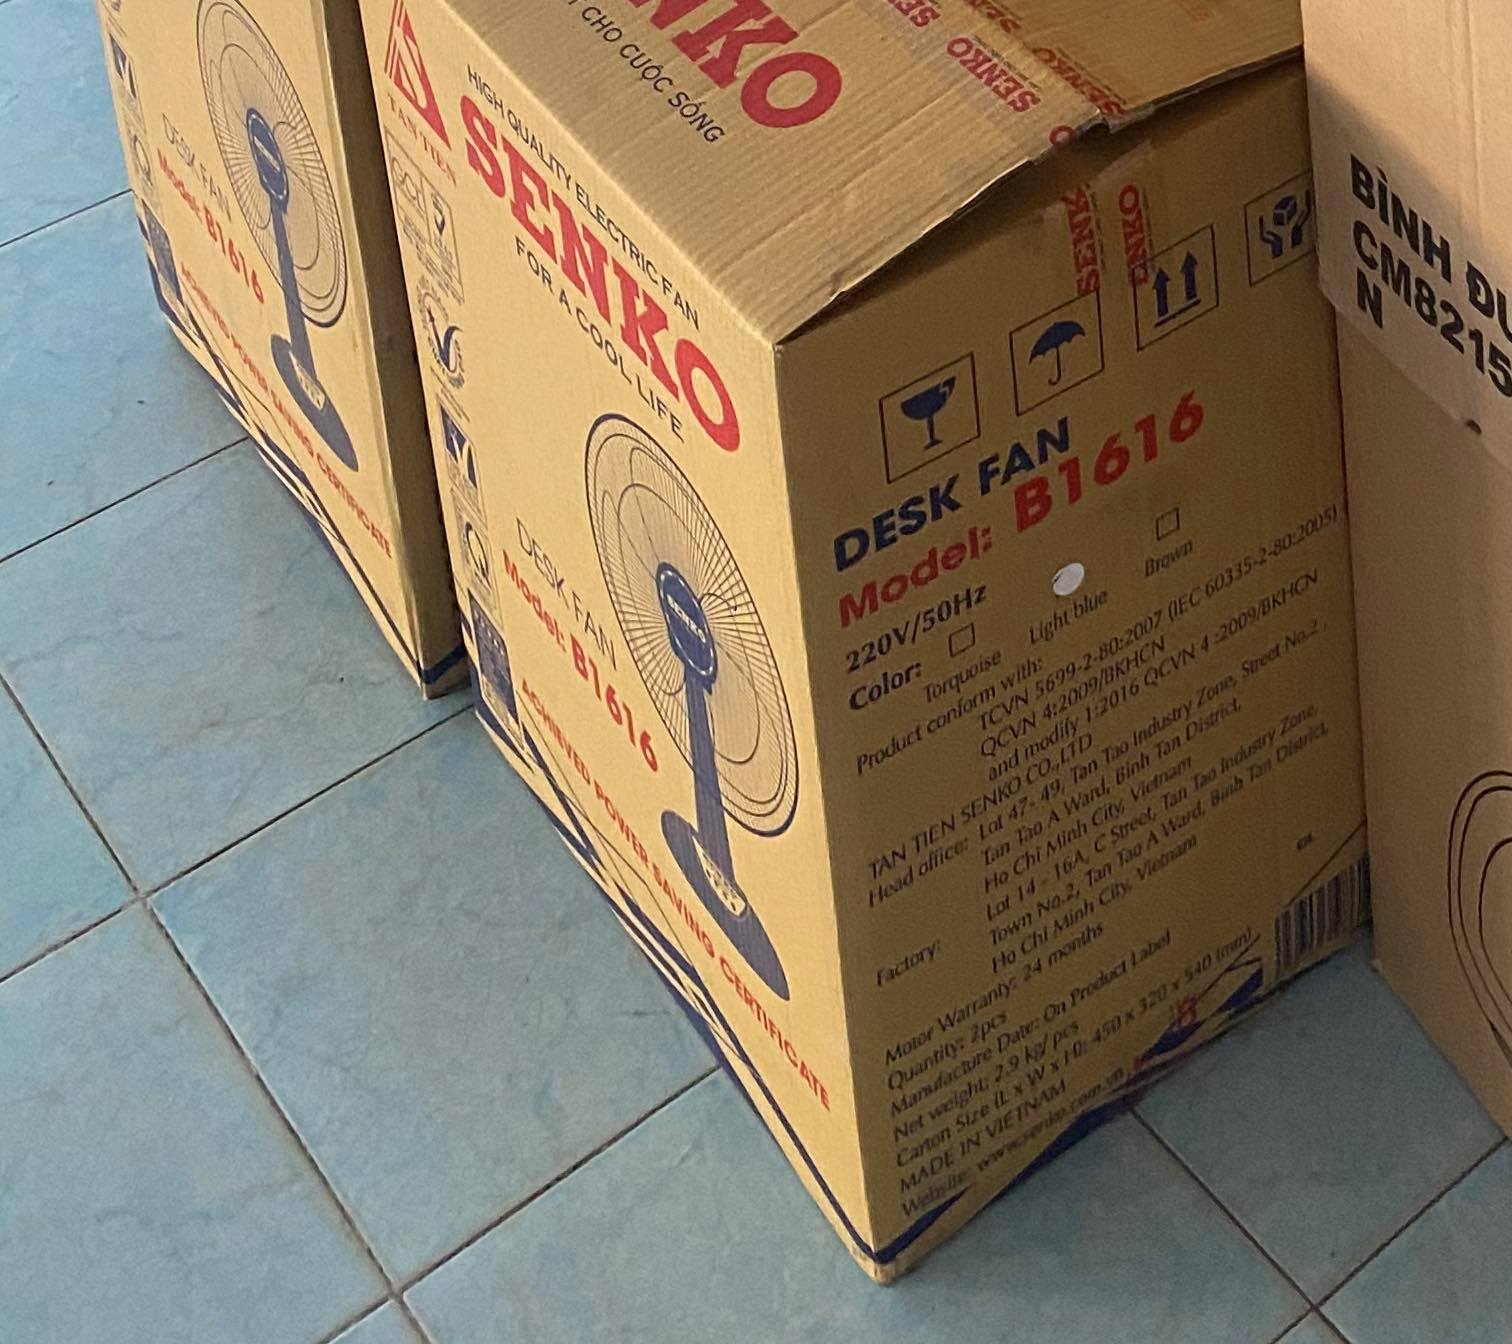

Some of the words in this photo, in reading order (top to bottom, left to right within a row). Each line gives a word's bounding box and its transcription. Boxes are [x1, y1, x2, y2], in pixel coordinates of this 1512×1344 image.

[579, 2, 622, 45] CHO
[618, 40, 672, 94] CUỘC
[669, 87, 727, 145] SỐNG
[946, 36, 1041, 114] SENKO
[460, 96, 740, 452] SENKO
[1350, 154, 1450, 281] BÌNH
[1356, 270, 1383, 330] N
[833, 473, 962, 572] DESK
[978, 416, 1072, 496] FAN
[838, 526, 993, 628] Model:
[1013, 389, 1205, 534] B1616
[845, 582, 988, 673] 220V/50Hz
[849, 662, 923, 711] Color:
[885, 1028, 935, 1066] Motor
[937, 977, 1021, 1030] Warranty:
[1022, 963, 1044, 988] 24
[1047, 923, 1103, 968] months
[900, 1150, 954, 1192] MADE
[959, 1133, 981, 1162] IN
[985, 1079, 1066, 1133] VIETNAM
